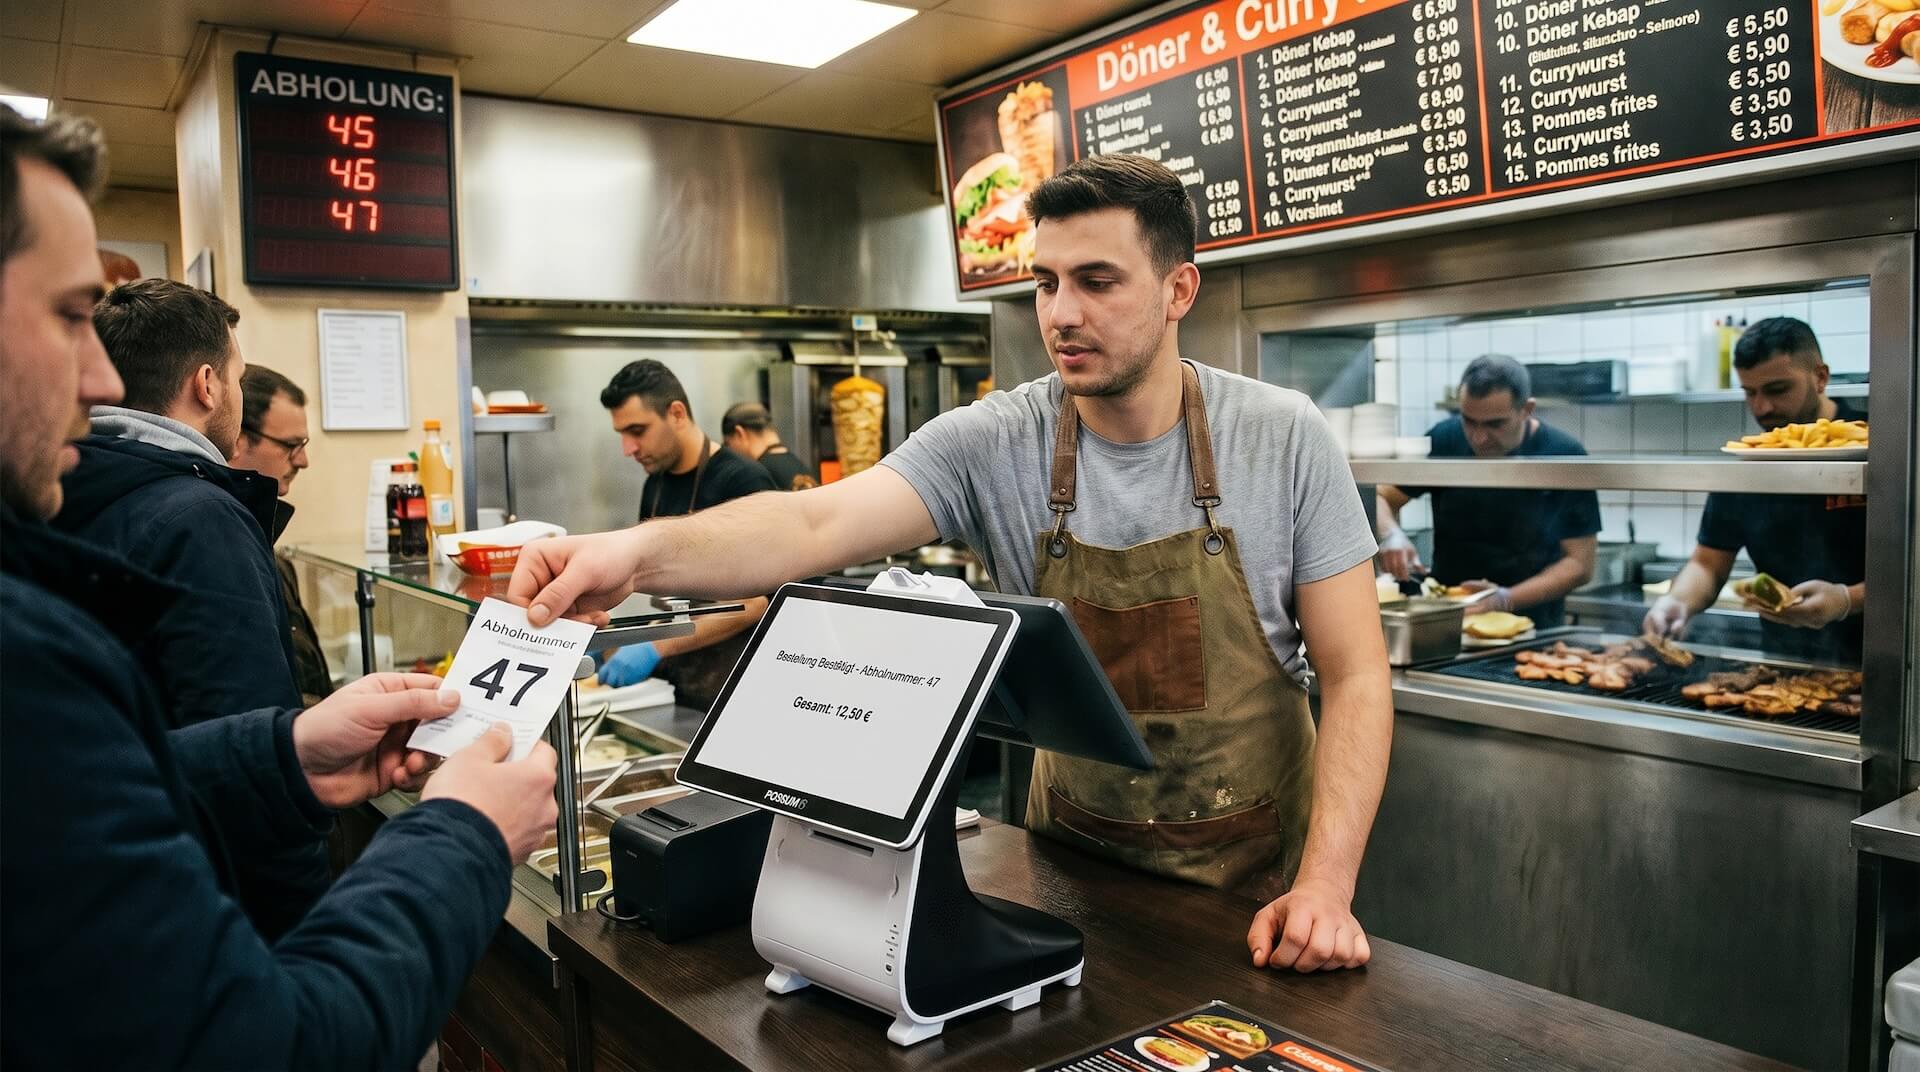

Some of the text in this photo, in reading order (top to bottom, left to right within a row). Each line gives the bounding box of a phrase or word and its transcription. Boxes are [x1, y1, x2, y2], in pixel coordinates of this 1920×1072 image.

[1256, 54, 1269, 70] 1.
[1272, 41, 1311, 66] Döner
[1312, 28, 1356, 53] Kebap
[1425, 0, 1457, 19] 6,90
[1494, 0, 1577, 32] 10. Döner
[1497, 4, 1640, 54] 10. Döner Kebap
[1097, 0, 1338, 92] Döner & Curry
[1258, 73, 1271, 90] 2.
[1274, 62, 1312, 86] Döner
[1314, 49, 1357, 74] Kebap
[1426, 17, 1459, 41] 6,90
[1259, 93, 1272, 109] 3.
[1275, 83, 1315, 105] Döner
[1315, 71, 1358, 94] Kebap
[1428, 39, 1460, 64] 8,90
[1499, 74, 1522, 95] 11.
[1529, 48, 1626, 87] Currywurst
[1725, 17, 1740, 38] €
[1501, 32, 1790, 116] 12. Currywurst € 5,90
[250, 69, 444, 113] ABHOLUNG:
[1261, 112, 1274, 128] 4.
[1277, 93, 1348, 124] Currywurst
[1429, 62, 1462, 86] 7,90
[1431, 84, 1464, 108] 8,90
[1502, 60, 1791, 139] 13. Pommes frites € 5,50
[328, 114, 375, 149] 45
[1265, 152, 1277, 168] 7.
[1433, 107, 1465, 130] 2,90
[1503, 87, 1792, 162] 14. Currywurst € 3,50
[1505, 113, 1793, 184] 15. Pommes frites € 3,50
[330, 158, 376, 191] 46
[1267, 171, 1279, 187] 8.
[1435, 129, 1467, 152] 3,50
[1269, 191, 1281, 207] 9.
[1284, 176, 1356, 204] Currywurst
[1437, 151, 1469, 175] 6,50
[332, 201, 378, 231] 47
[1263, 210, 1284, 227] 10.
[481, 619, 577, 650] Abholnummer
[469, 657, 549, 707] 47
[793, 696, 873, 722] Gesamt: 12,50 €
[927, 677, 941, 688] 47
